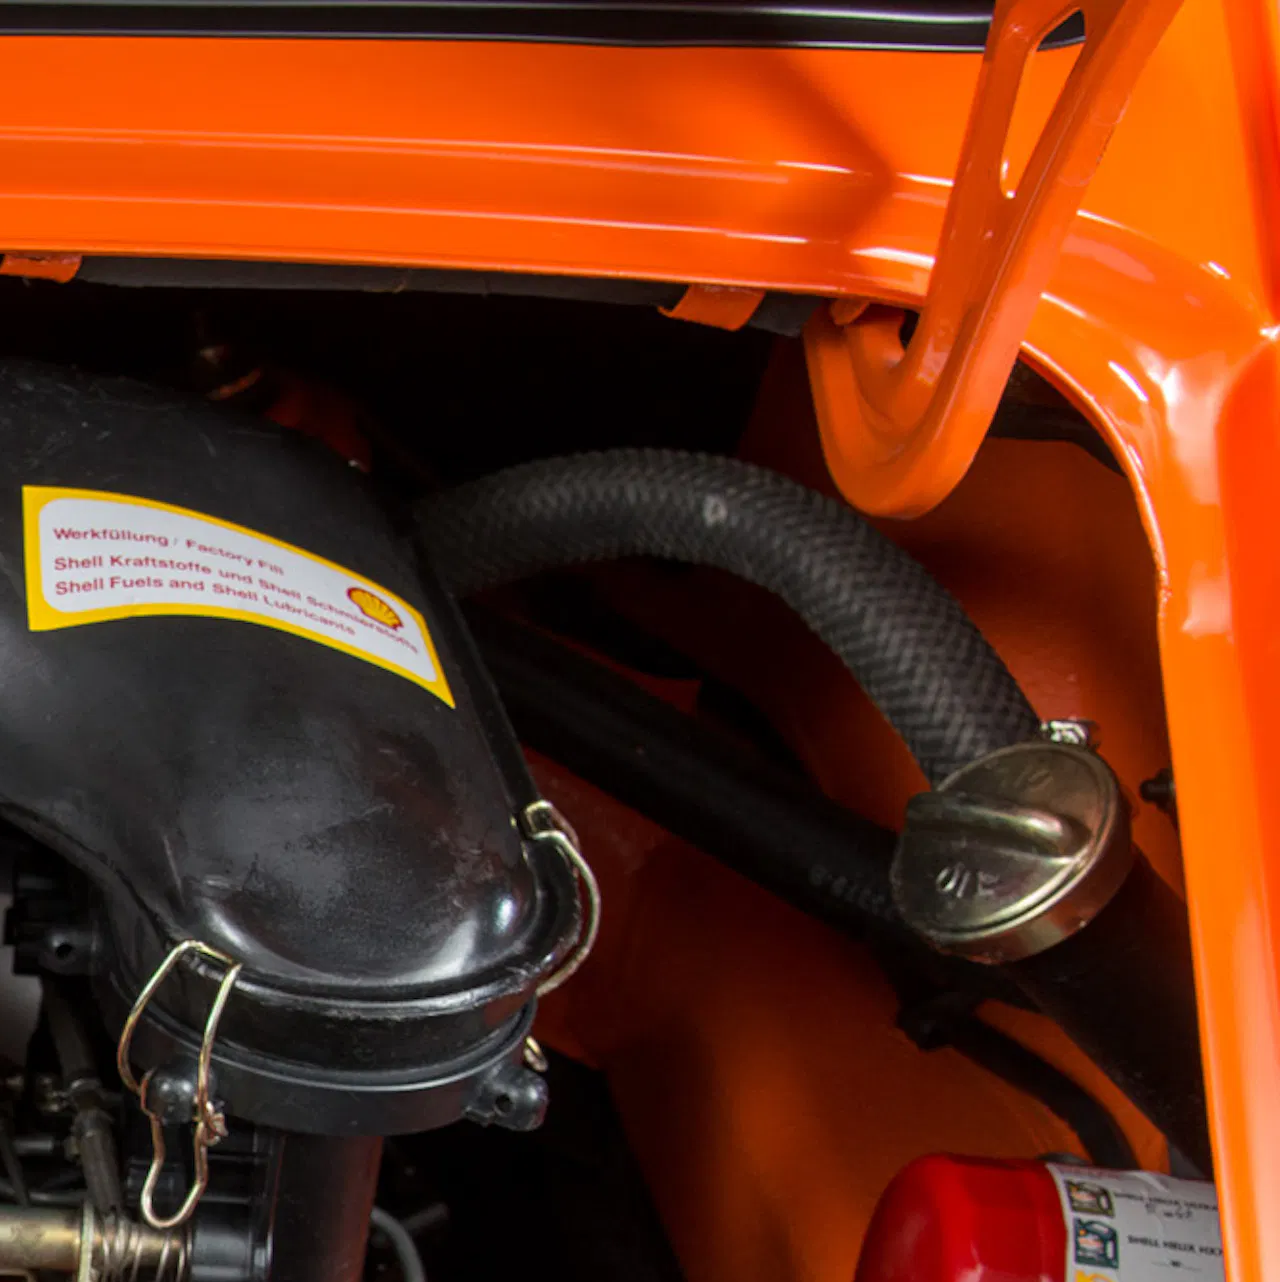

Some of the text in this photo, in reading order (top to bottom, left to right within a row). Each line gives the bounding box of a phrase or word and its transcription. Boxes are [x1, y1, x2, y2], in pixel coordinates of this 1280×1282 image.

[52, 526, 169, 548] Werkfüllung
[184, 537, 253, 568] Factory
[258, 557, 284, 577] Fill
[54, 554, 104, 571] Shell
[109, 552, 212, 577] Kraftstoffe
[217, 565, 253, 586] und
[257, 577, 302, 602] Shell
[54, 574, 356, 637] Shell Fuels and Shell Lubricants
[1127, 1234, 1159, 1248] SHELL
